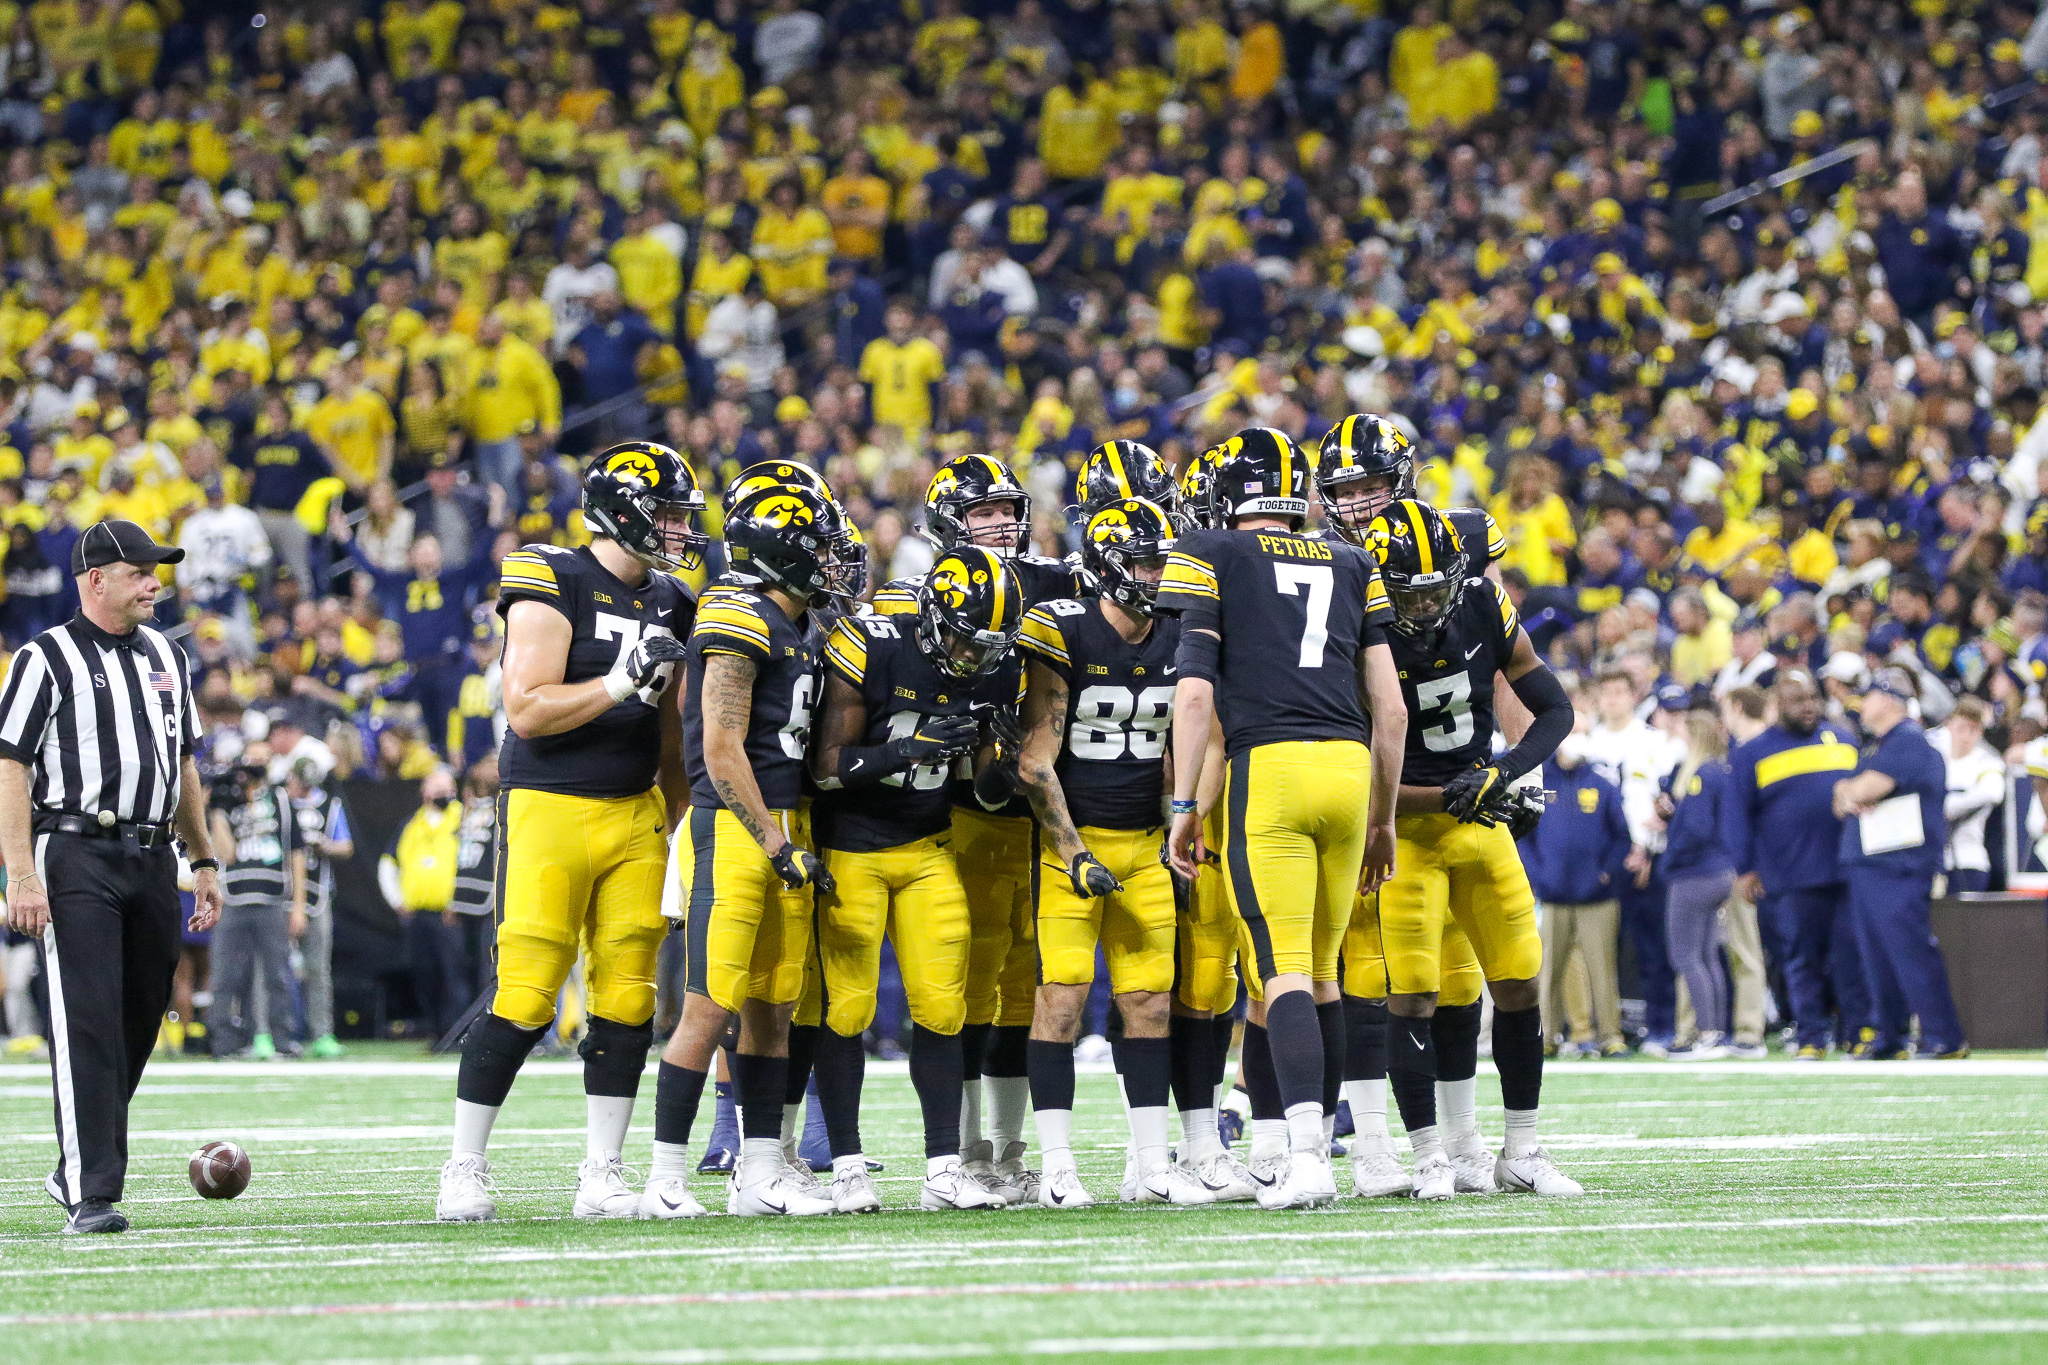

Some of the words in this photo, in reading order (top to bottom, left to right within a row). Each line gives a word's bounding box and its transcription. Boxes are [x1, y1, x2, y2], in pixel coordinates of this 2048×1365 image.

[1292, 470, 1304, 492] 7
[1340, 467, 1355, 475] IOWA
[1257, 534, 1333, 560] PETRAS
[1273, 561, 1334, 667] 7
[94, 673, 106, 689] S
[1417, 670, 1474, 751] 3
[164, 713, 176, 737] C
